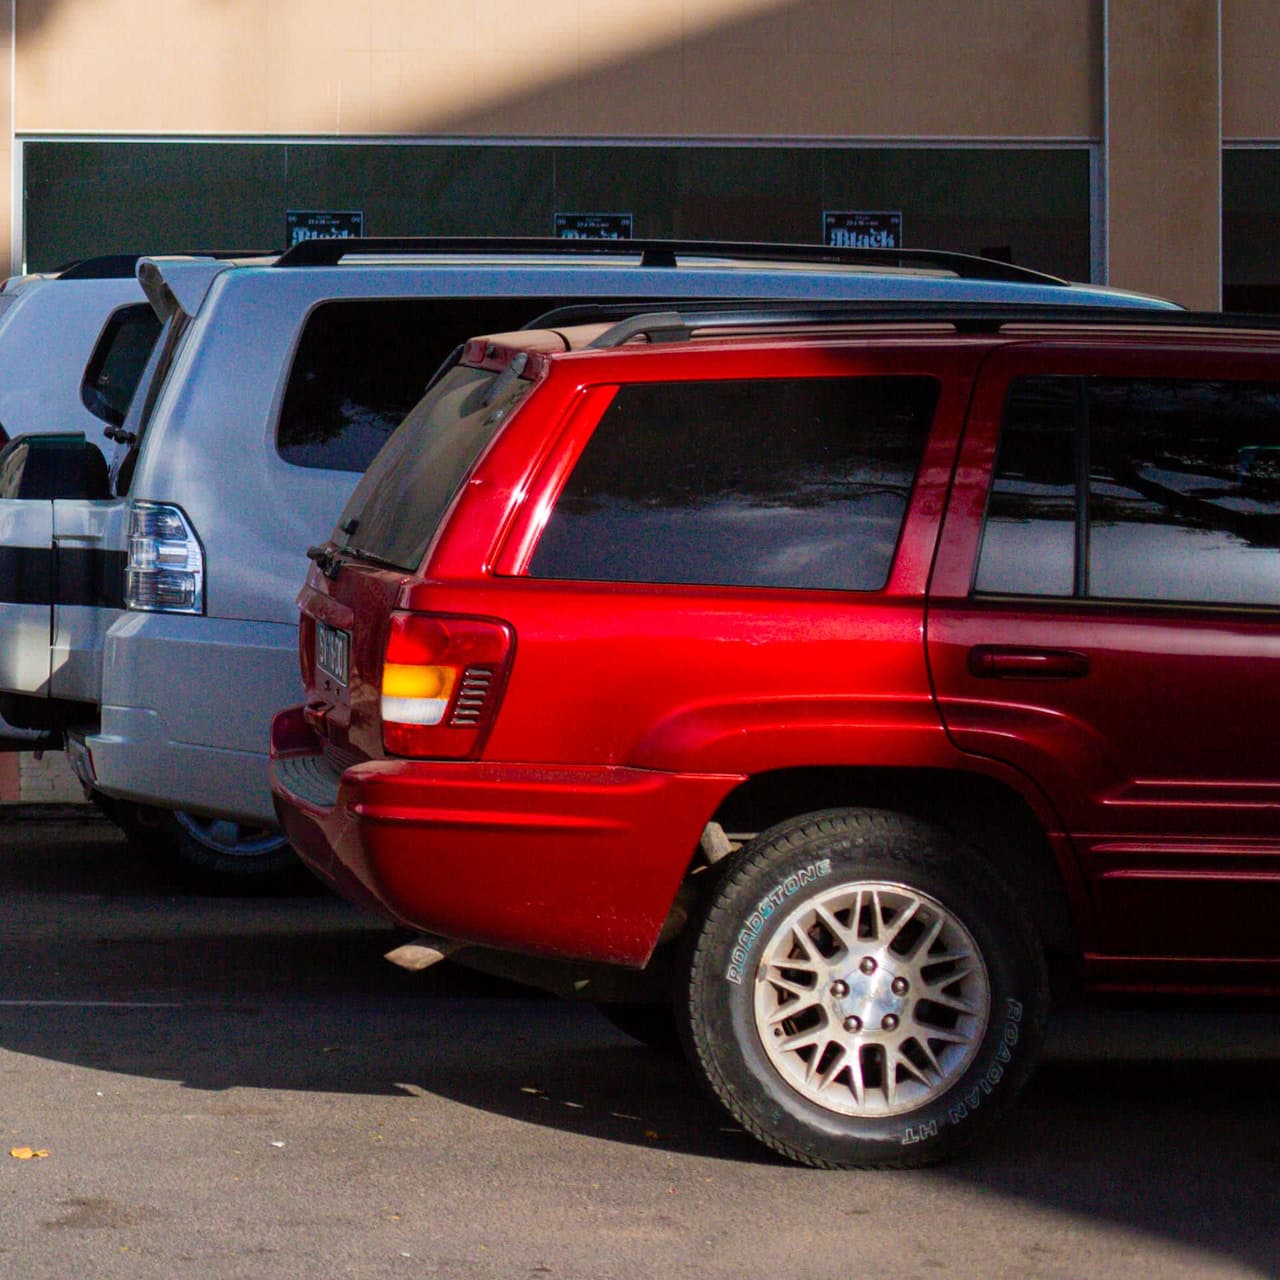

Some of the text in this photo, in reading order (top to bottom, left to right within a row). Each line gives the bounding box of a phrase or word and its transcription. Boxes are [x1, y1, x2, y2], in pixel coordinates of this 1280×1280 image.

[726, 859, 832, 984] ROADSTONE
[902, 998, 1023, 1145] ROADIAN HT
